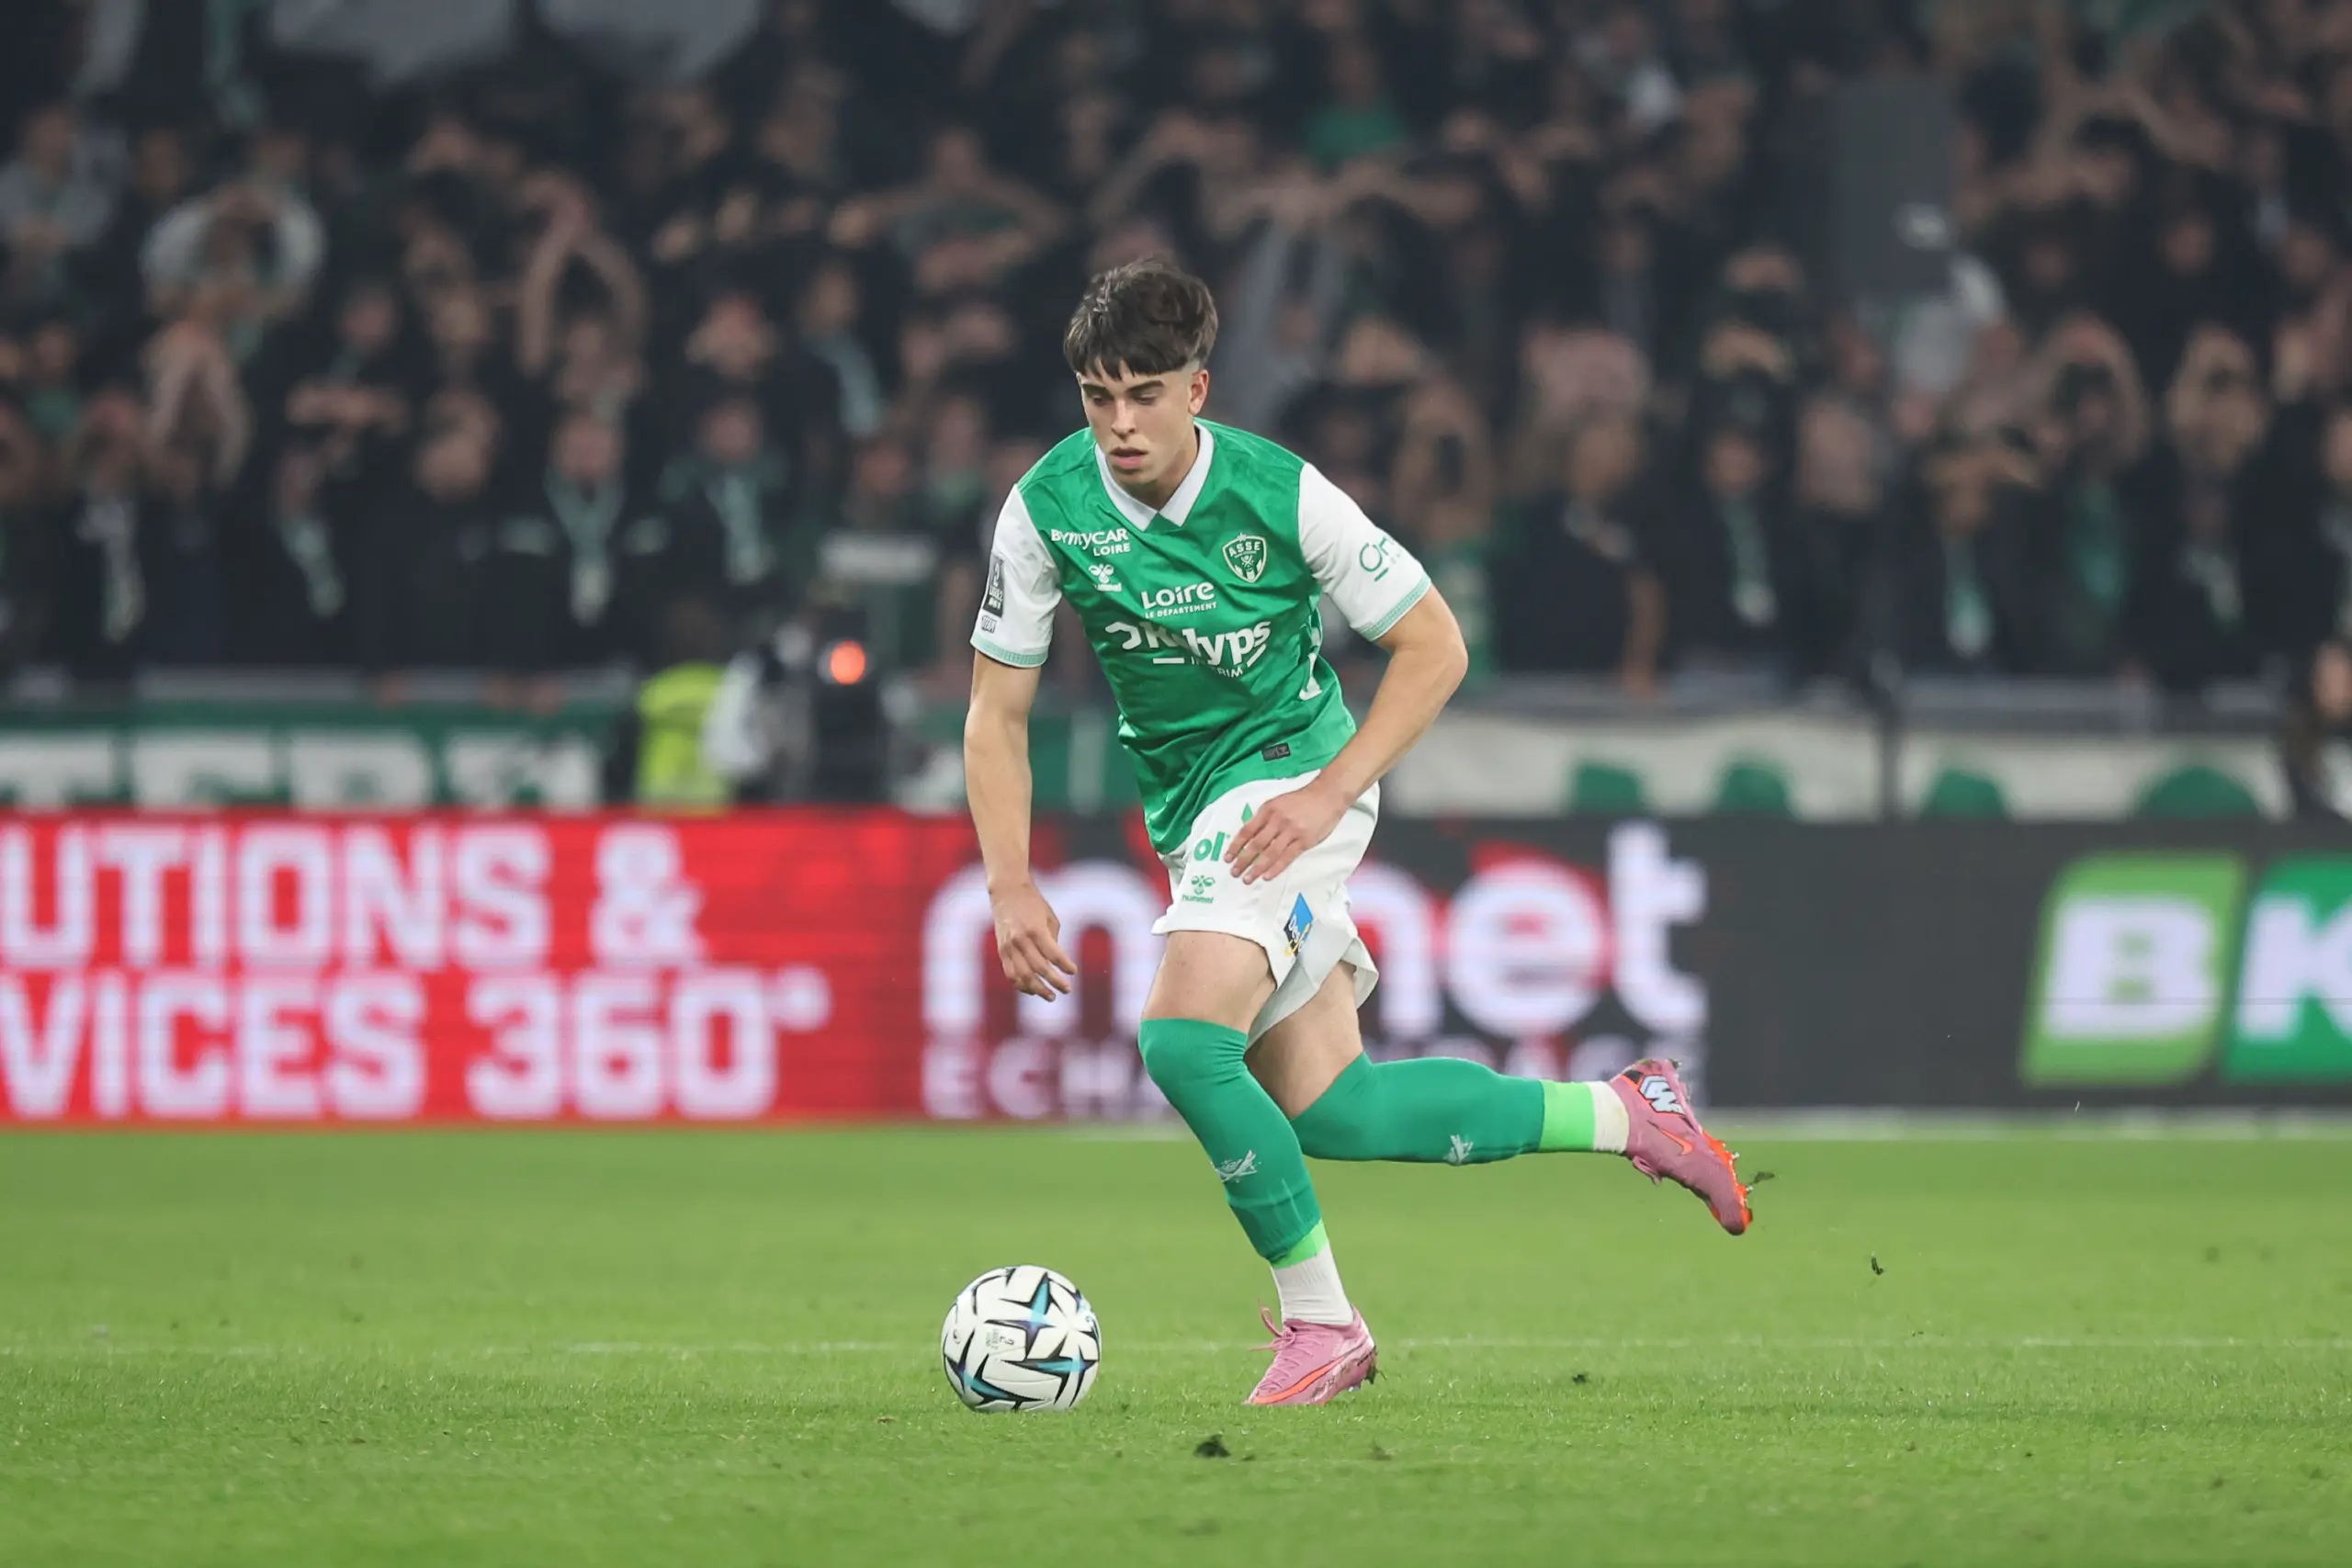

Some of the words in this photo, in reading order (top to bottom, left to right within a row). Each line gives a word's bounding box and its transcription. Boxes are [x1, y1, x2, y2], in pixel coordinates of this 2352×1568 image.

[1092, 542, 1131, 557] LOIRE
[1228, 541, 1261, 558] ASSE
[1141, 581, 1216, 609] Loire
[1157, 602, 1217, 617] DÉPARTEMENT
[0, 820, 554, 970] UTIONS
[591, 820, 706, 970] &
[1182, 894, 1215, 904] hummel
[2046, 891, 2352, 1042] BK
[0, 971, 426, 1119] VICES
[465, 968, 830, 1119] 360°
